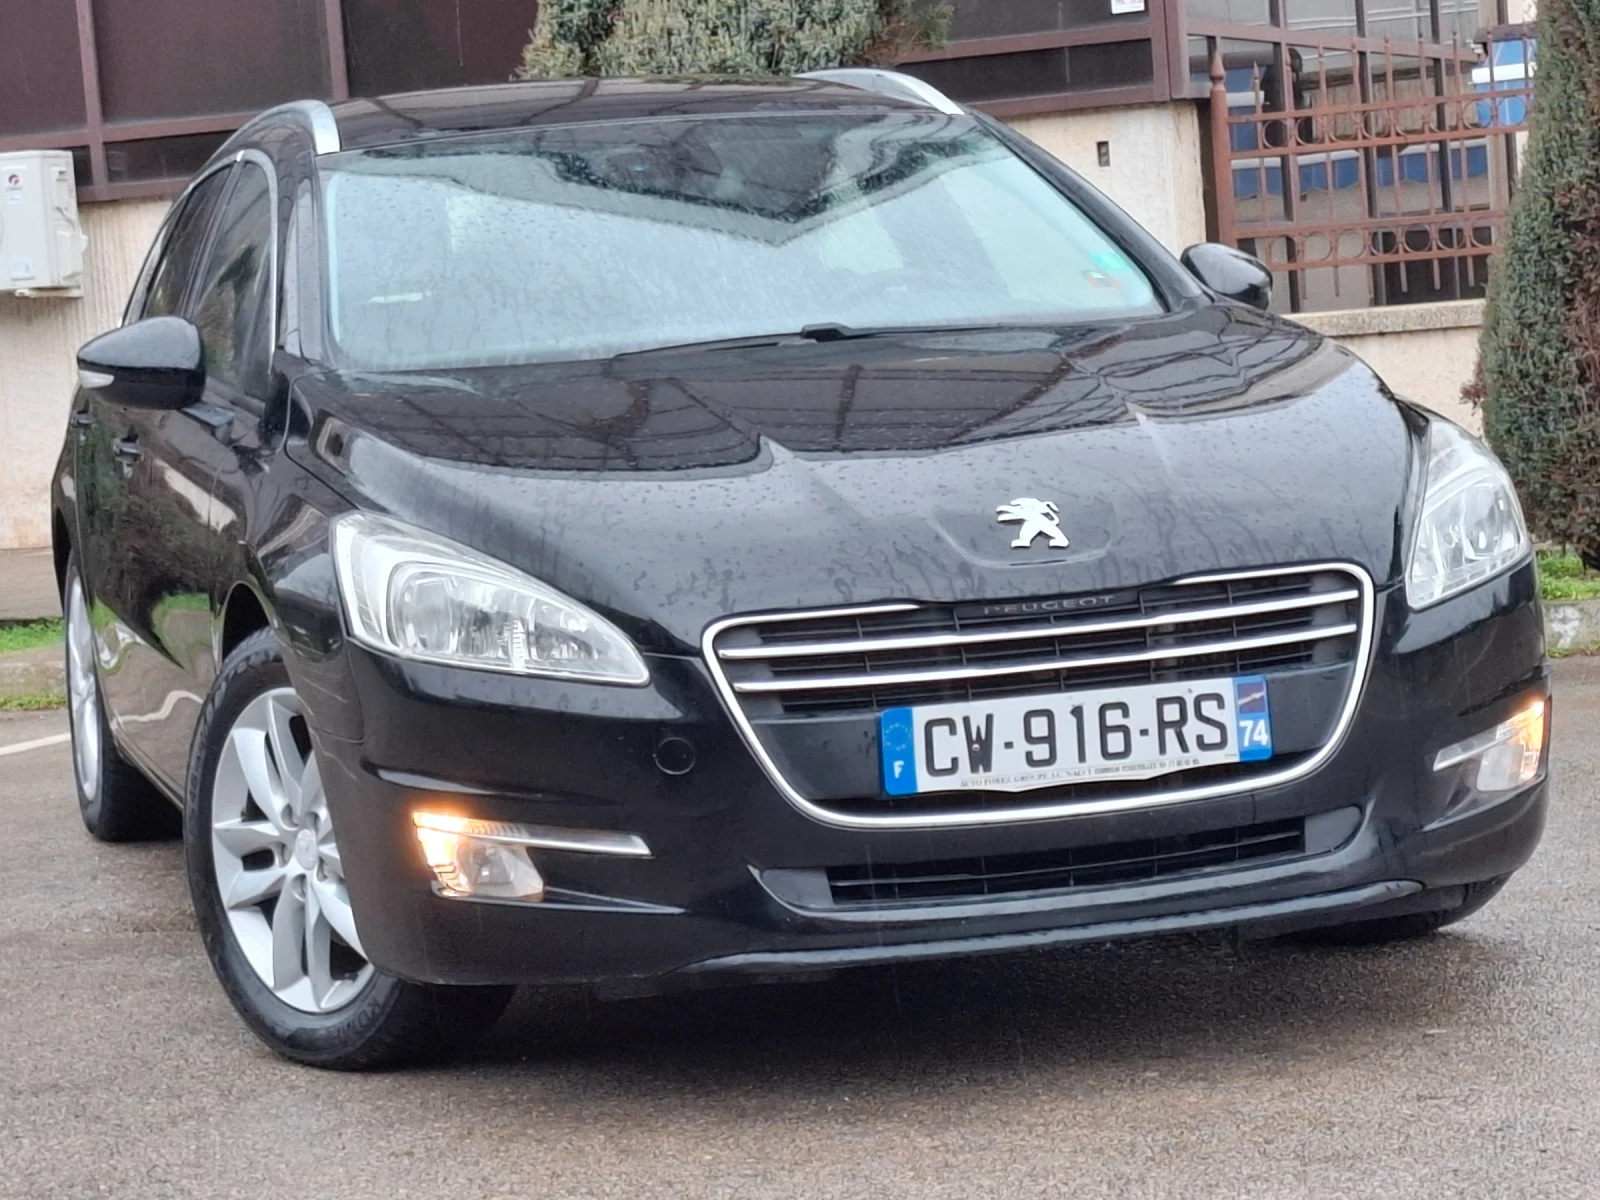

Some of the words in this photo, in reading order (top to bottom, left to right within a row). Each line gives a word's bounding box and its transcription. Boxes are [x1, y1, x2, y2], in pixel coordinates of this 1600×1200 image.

[983, 595, 1115, 615] PEUGEOT
[924, 692, 1229, 778] CW-916-RS
[1239, 719, 1269, 747] 74
[893, 760, 905, 779] F
